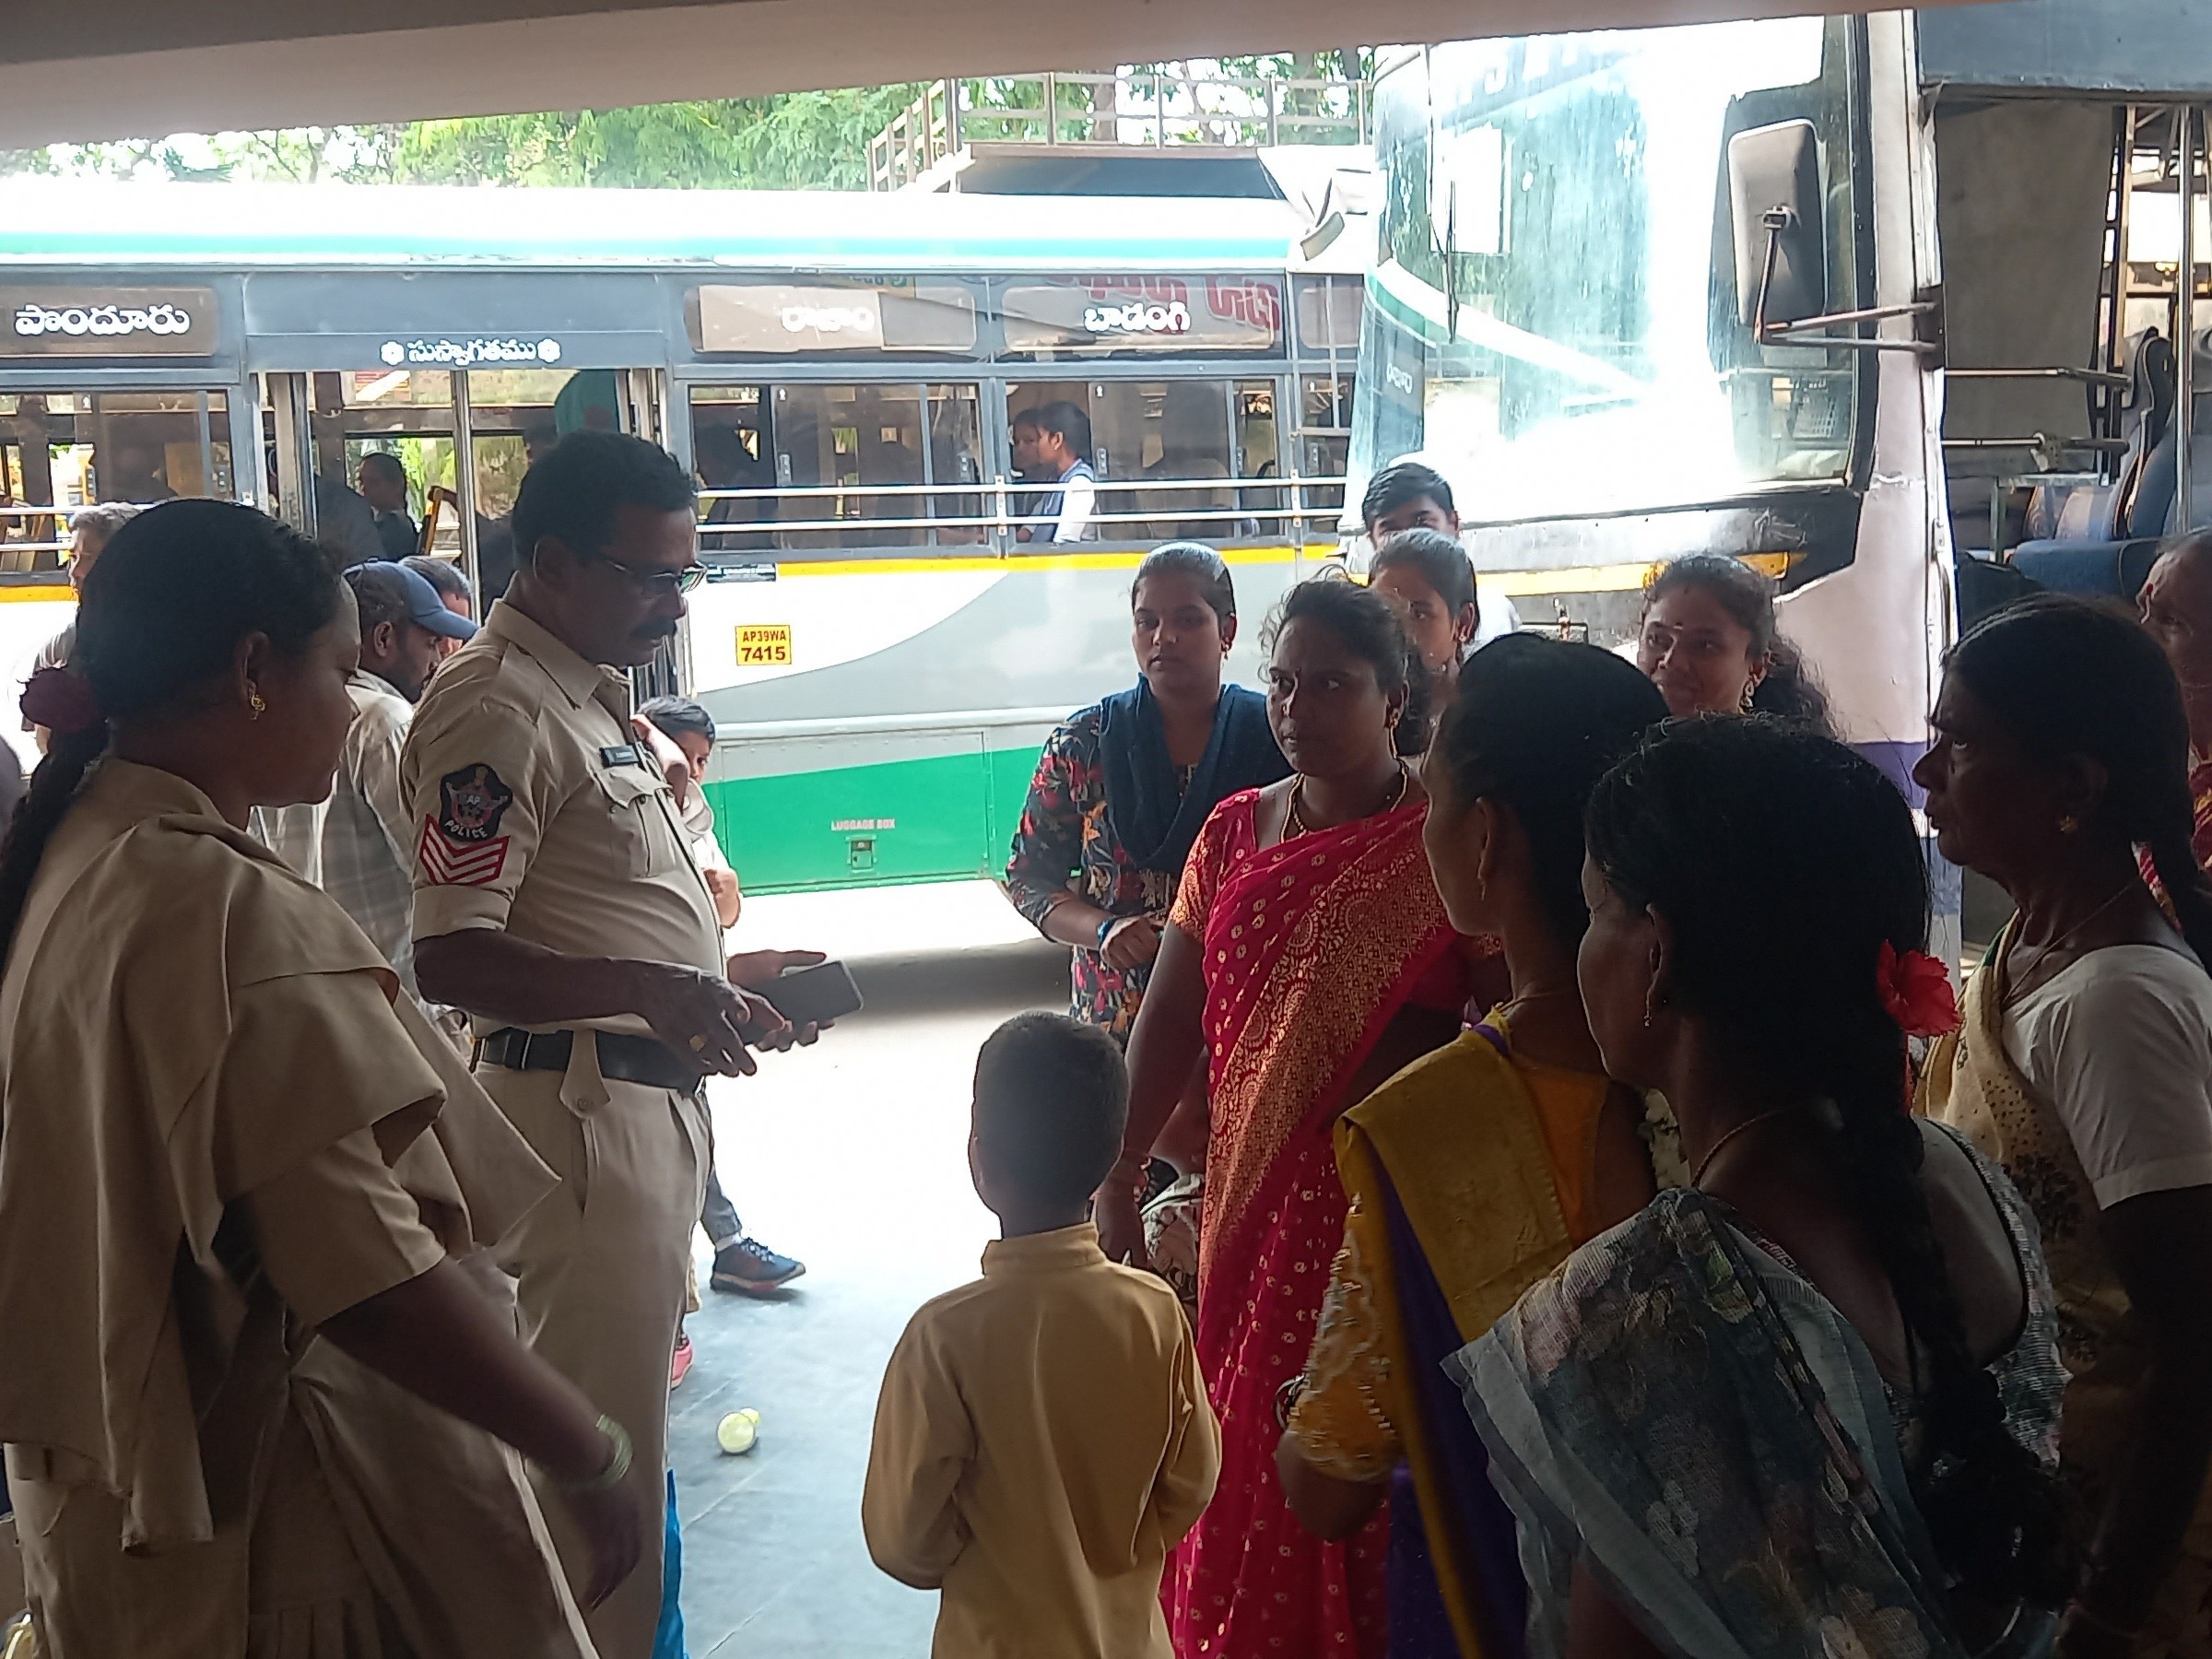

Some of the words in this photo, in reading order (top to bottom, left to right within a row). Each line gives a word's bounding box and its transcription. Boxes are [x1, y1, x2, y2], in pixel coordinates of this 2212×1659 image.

[15, 303, 192, 336] పొందూరు
[1083, 300, 1192, 333] బాడంగి
[406, 337, 537, 367] సుస్వాగతము
[743, 630, 786, 642] AP39WA
[741, 646, 786, 662] 7415
[444, 819, 488, 839] POLICE
